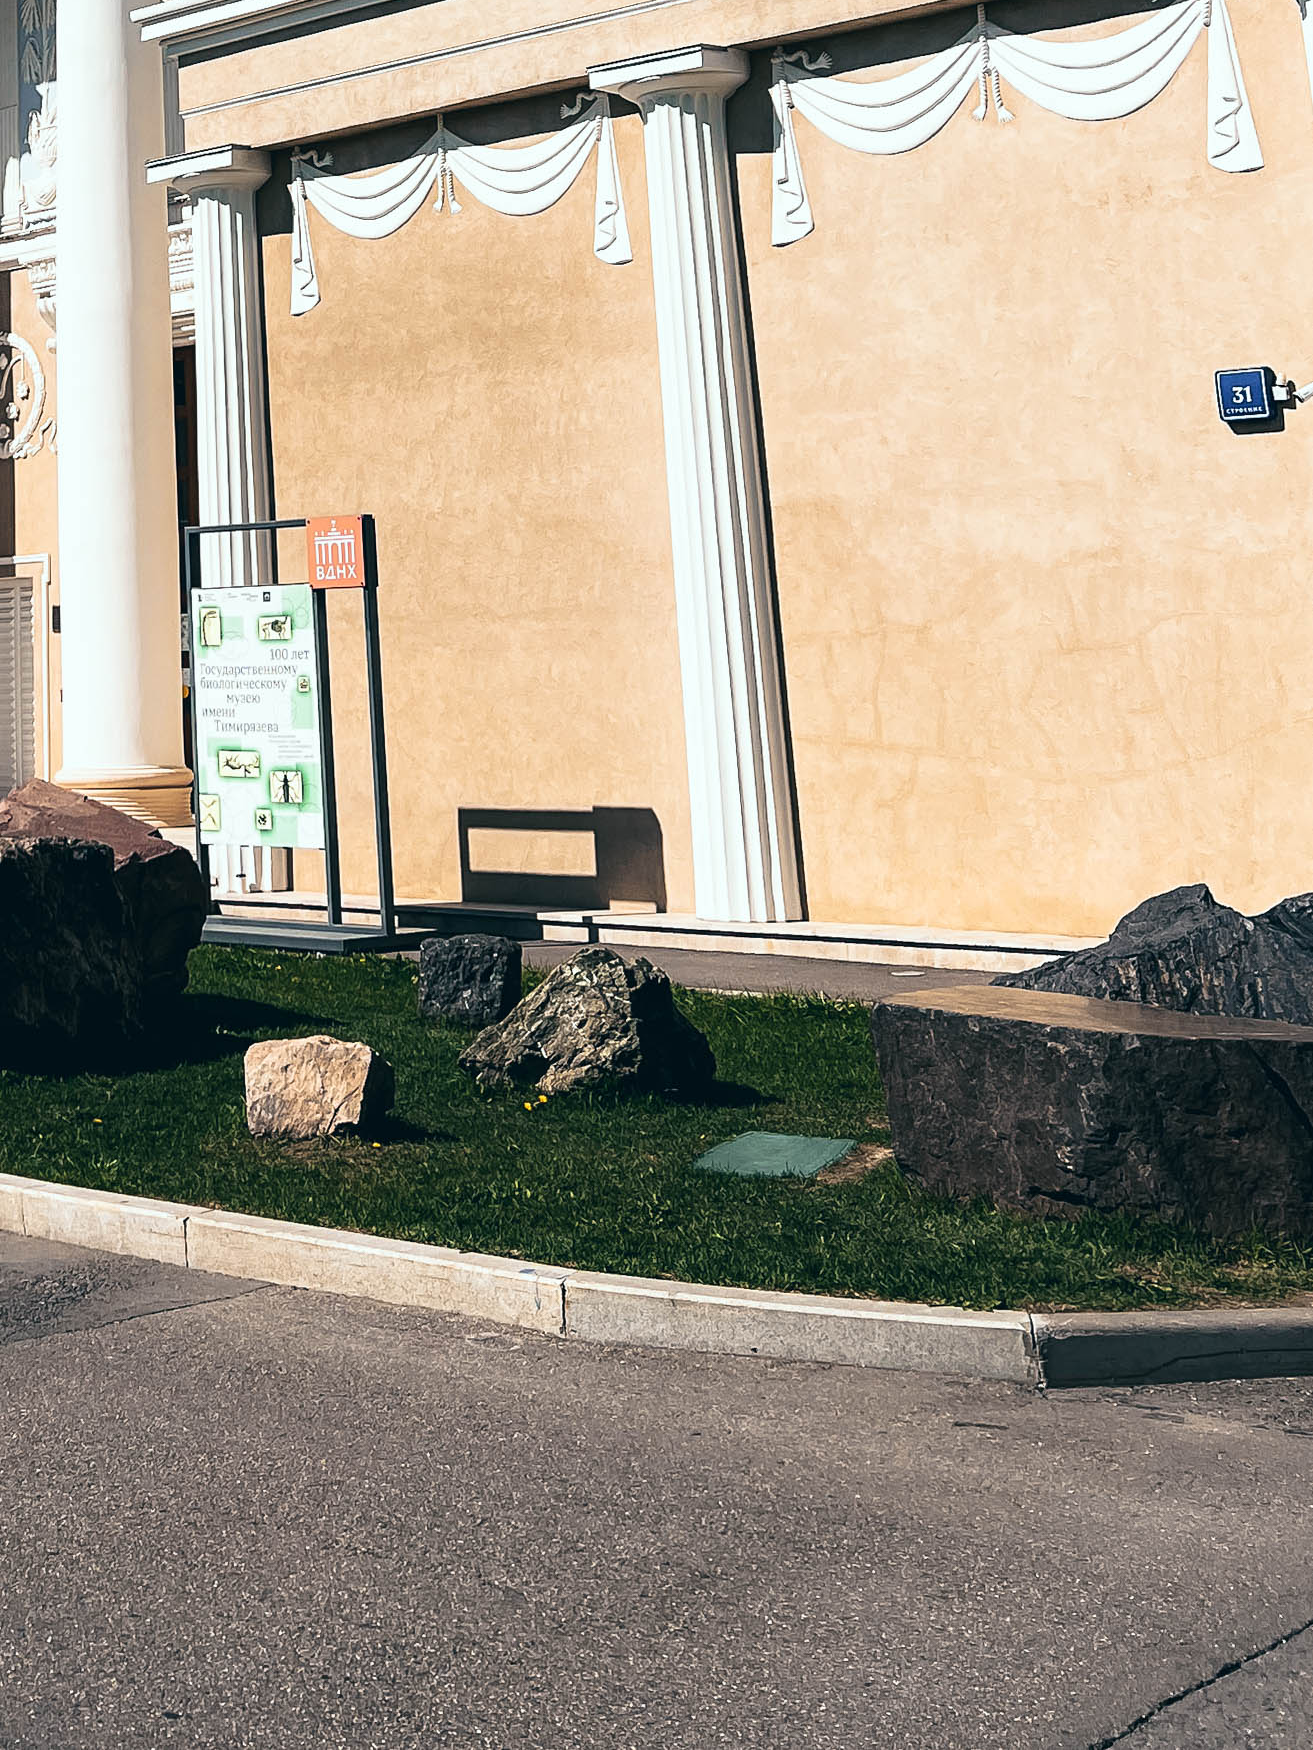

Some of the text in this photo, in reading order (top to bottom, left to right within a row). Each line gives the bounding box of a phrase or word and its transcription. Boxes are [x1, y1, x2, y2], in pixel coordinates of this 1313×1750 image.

[1232, 386, 1252, 404] 31
[316, 564, 357, 580] ВДНХ
[270, 648, 310, 660] 100 лет
[200, 663, 298, 677] Государственному
[200, 676, 287, 692] биологическому
[226, 694, 261, 706] музею
[202, 707, 235, 718] имени
[214, 719, 279, 735] Тимирязева
